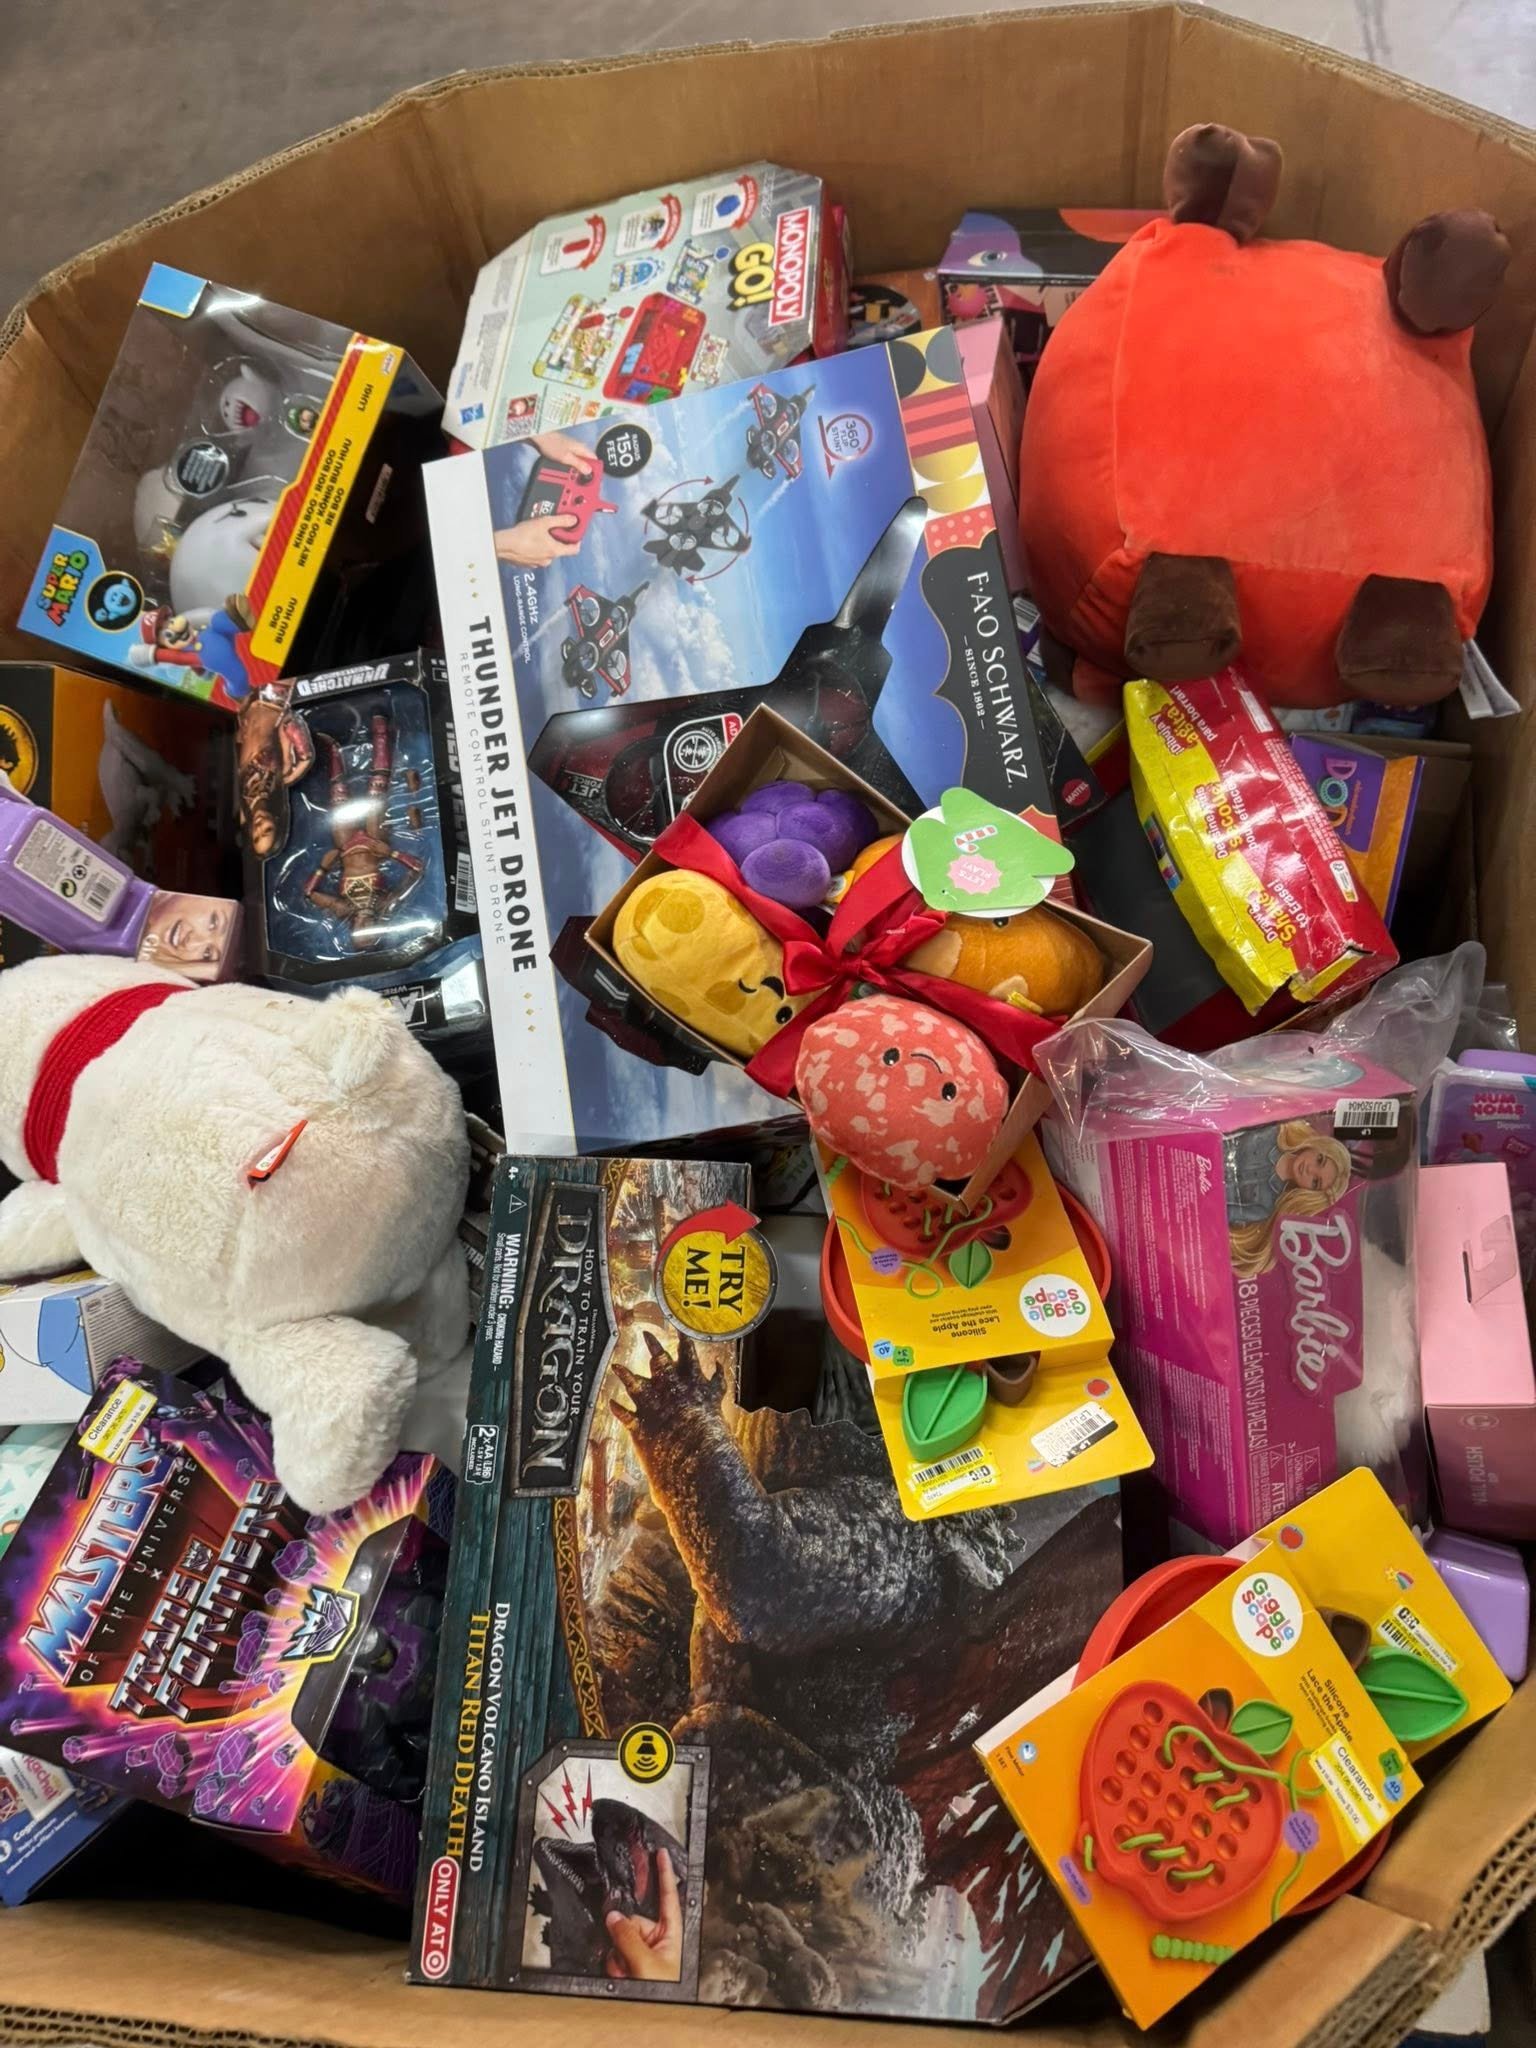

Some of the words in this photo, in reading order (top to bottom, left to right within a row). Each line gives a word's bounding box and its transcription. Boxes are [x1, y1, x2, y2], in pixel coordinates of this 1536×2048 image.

[734, 242, 775, 308] GO!
[773, 210, 809, 318] MONOPOLY
[356, 383, 375, 412] LUIGI
[606, 440, 618, 467] FEET
[615, 432, 634, 468] 150
[631, 434, 641, 461] RADIUS
[830, 426, 843, 453] STUNT
[839, 430, 849, 448] FLIP
[292, 522, 309, 549] KING
[302, 498, 318, 522] BOO
[314, 473, 328, 493] ROI
[321, 449, 337, 473] BOO
[329, 487, 346, 511] BOO
[296, 545, 312, 567] REY
[305, 522, 321, 546] BOO
[37, 552, 69, 610] SUPER
[47, 550, 89, 627] MARIO
[268, 605, 285, 629] BOO
[274, 620, 290, 644] BUU
[283, 597, 299, 621] HUU
[513, 576, 526, 625] LONG-RANGE
[520, 627, 531, 664] CONTROL
[298, 664, 390, 695] UNMATCHED
[461, 652, 476, 721] REMOTE
[965, 649, 979, 688] SINCE
[469, 616, 509, 775] THUNDER
[1170, 686, 1199, 721] borrar!
[1168, 705, 1199, 743] agita
[1199, 720, 1218, 741] para
[468, 728, 486, 812] CONTROL
[569, 784, 599, 797] JET
[1063, 785, 1091, 802] MATTEL
[496, 785, 520, 841] JET
[481, 818, 493, 874] STUNT
[490, 883, 504, 945] DRONE
[501, 855, 536, 972] DRONE
[1268, 878, 1301, 915] Erase!
[1469, 1104, 1526, 1118] NOMS
[1472, 1093, 1517, 1105] NUM
[1362, 1128, 1372, 1136] LP
[508, 1166, 518, 1180] 4+
[1195, 1154, 1214, 1196] Barbie
[496, 1233, 506, 1247] Small
[492, 1274, 501, 1282] for
[493, 1264, 502, 1273] Not
[498, 1233, 521, 1309] WARNING:
[584, 1249, 596, 1287] HOW
[683, 1247, 710, 1308] ME!
[717, 1244, 746, 1316] TRY
[1238, 1273, 1258, 1298] 18
[488, 1304, 496, 1319] under
[489, 1282, 499, 1304] children
[581, 1292, 591, 1311] TO
[1280, 1213, 1353, 1392] Barbie
[495, 1313, 507, 1339] CHOKING
[932, 1322, 959, 1332] Apple
[951, 1327, 987, 1338] Silicone
[962, 1320, 977, 1328] the
[979, 1316, 1000, 1325] Lace
[492, 1340, 504, 1364] HAZARD
[521, 1203, 593, 1478] DRAGON
[576, 1317, 589, 1365] TRAIN
[878, 1346, 889, 1355] 40
[570, 1370, 583, 1416] YOUR
[89, 1398, 122, 1440] Clearance
[469, 1437, 477, 1470] INCLUDED
[1466, 1446, 1486, 1482] POLISH
[1471, 1483, 1487, 1506] NAIL
[22, 1439, 171, 1688] MASTERS
[79, 1654, 101, 1683] OF
[101, 1587, 136, 1637] THE
[135, 1456, 198, 1574] UNIVERSE
[153, 1478, 291, 1723] FORMERS
[109, 1570, 204, 1720] TRANS
[464, 1610, 491, 1692] TITAN
[488, 1602, 510, 1688] DRAGON
[1305, 1669, 1325, 1694] Lace
[1320, 1693, 1336, 1712] the
[1332, 1712, 1355, 1743] Apple
[1323, 1679, 1352, 1719] Silicone
[457, 1699, 482, 1754] RED
[478, 1690, 501, 1791] VOLCANO
[1335, 1745, 1376, 1803] Clearance
[1389, 1781, 1400, 1793] 40
[447, 1761, 475, 1858] DEATH
[1334, 1787, 1348, 1805] Now
[1344, 1803, 1361, 1825] $3.00
[469, 1794, 491, 1872] ISLAND
[432, 1863, 452, 1914] ONLY
[429, 1922, 445, 1950] AT
